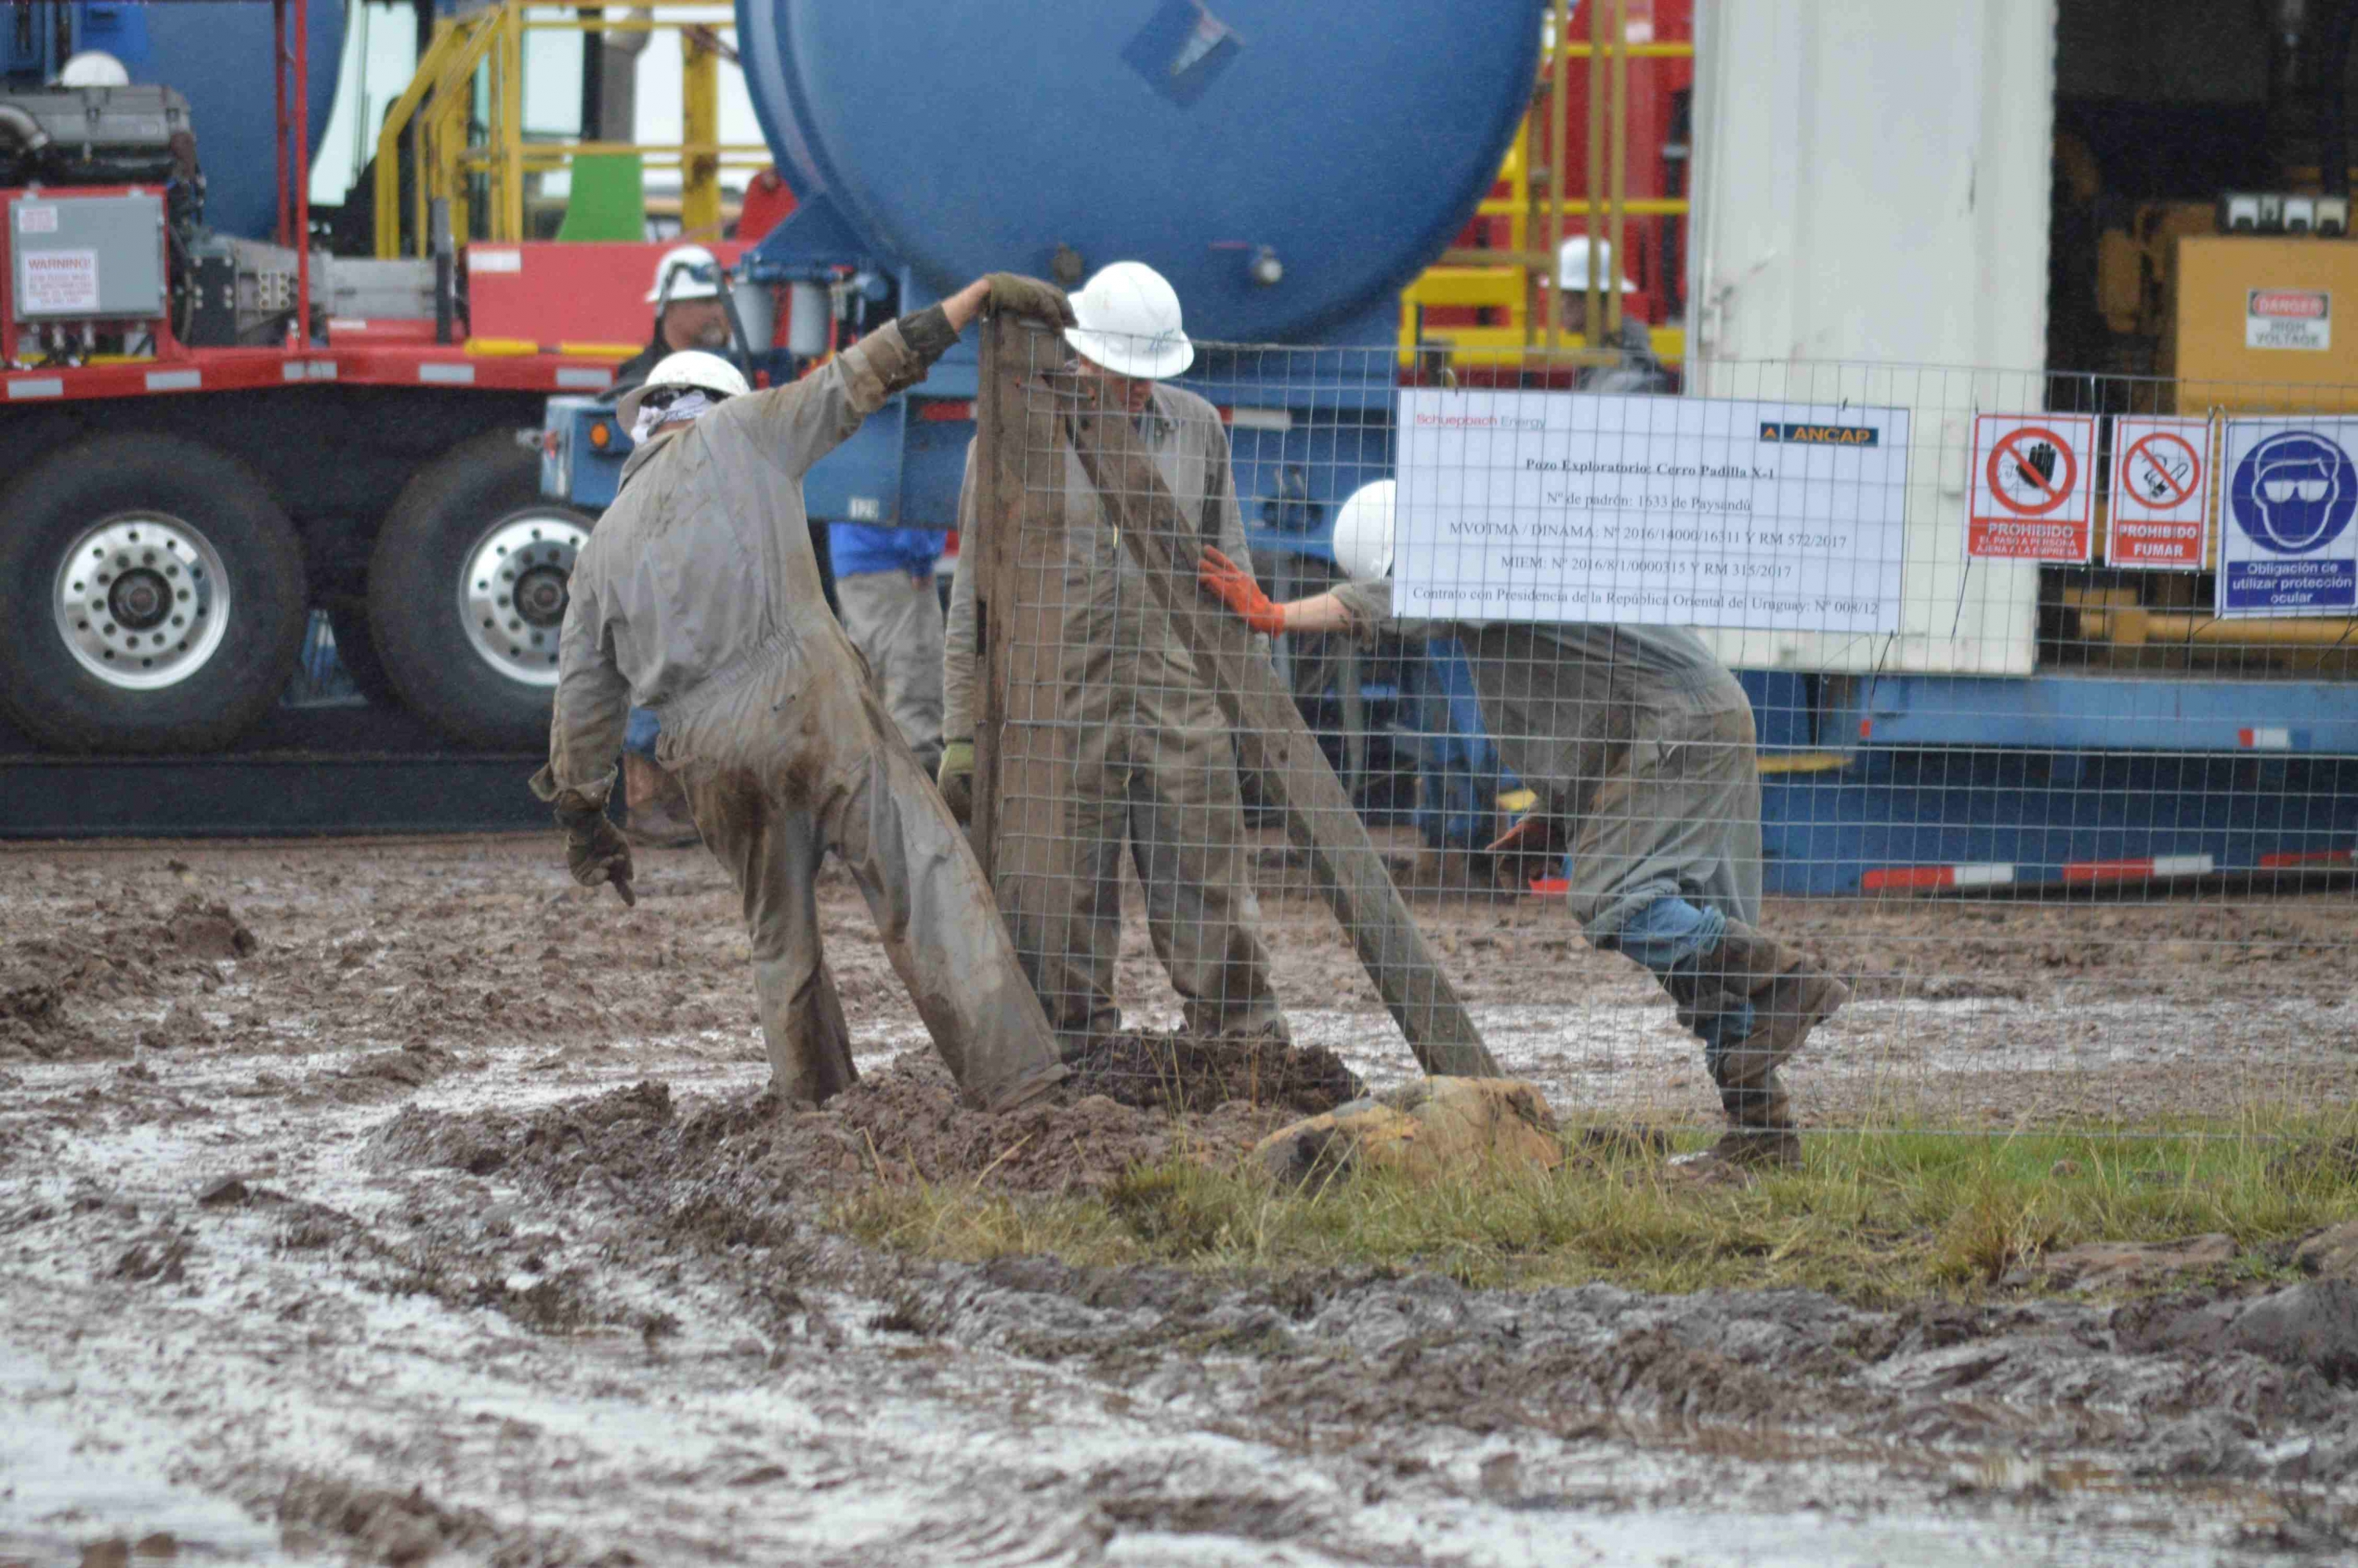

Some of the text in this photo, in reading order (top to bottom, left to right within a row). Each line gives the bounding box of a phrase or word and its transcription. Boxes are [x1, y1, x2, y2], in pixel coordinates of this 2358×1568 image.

[2258, 299, 2319, 313] DANGER
[2270, 321, 2306, 332] HIGH
[2256, 332, 2319, 344] VOLTAGE
[1416, 413, 1547, 430] Schuepbach Energy
[1793, 426, 1871, 444] ANCAP
[1526, 458, 1775, 480] Pozo Exploratorio: Cerro Padilla X-1
[1566, 492, 1581, 505] de
[1585, 494, 1633, 509] padrón:
[1672, 495, 1688, 509] de
[1691, 497, 1752, 514] Paysandú
[1449, 522, 1519, 536] MVOTMA
[1532, 523, 1600, 539] DINAMA:
[1746, 531, 1757, 545] Y
[1760, 532, 1783, 545] RM
[1787, 533, 1847, 549] 572/2017
[1989, 522, 2074, 538] PROHIBIDO
[2119, 524, 2198, 539] PROHIBIDO
[2133, 543, 2184, 556] FUMAR
[1501, 556, 1547, 570] MIEM:
[1690, 561, 1700, 574] Y
[1704, 563, 1728, 576] RM
[1732, 564, 1792, 578] 315/2017
[2246, 562, 2338, 577] Obligación de
[2232, 576, 2352, 592] utilizar protección
[1413, 588, 1467, 600] Contrato
[1470, 589, 1493, 601] con
[1497, 589, 1568, 603] Presidencia
[1572, 590, 1587, 604] de
[1590, 591, 1602, 604] la
[1607, 591, 1669, 608] República
[1673, 594, 1724, 608] Oriental
[1728, 595, 1747, 608] del
[2270, 593, 2313, 604] ocular
